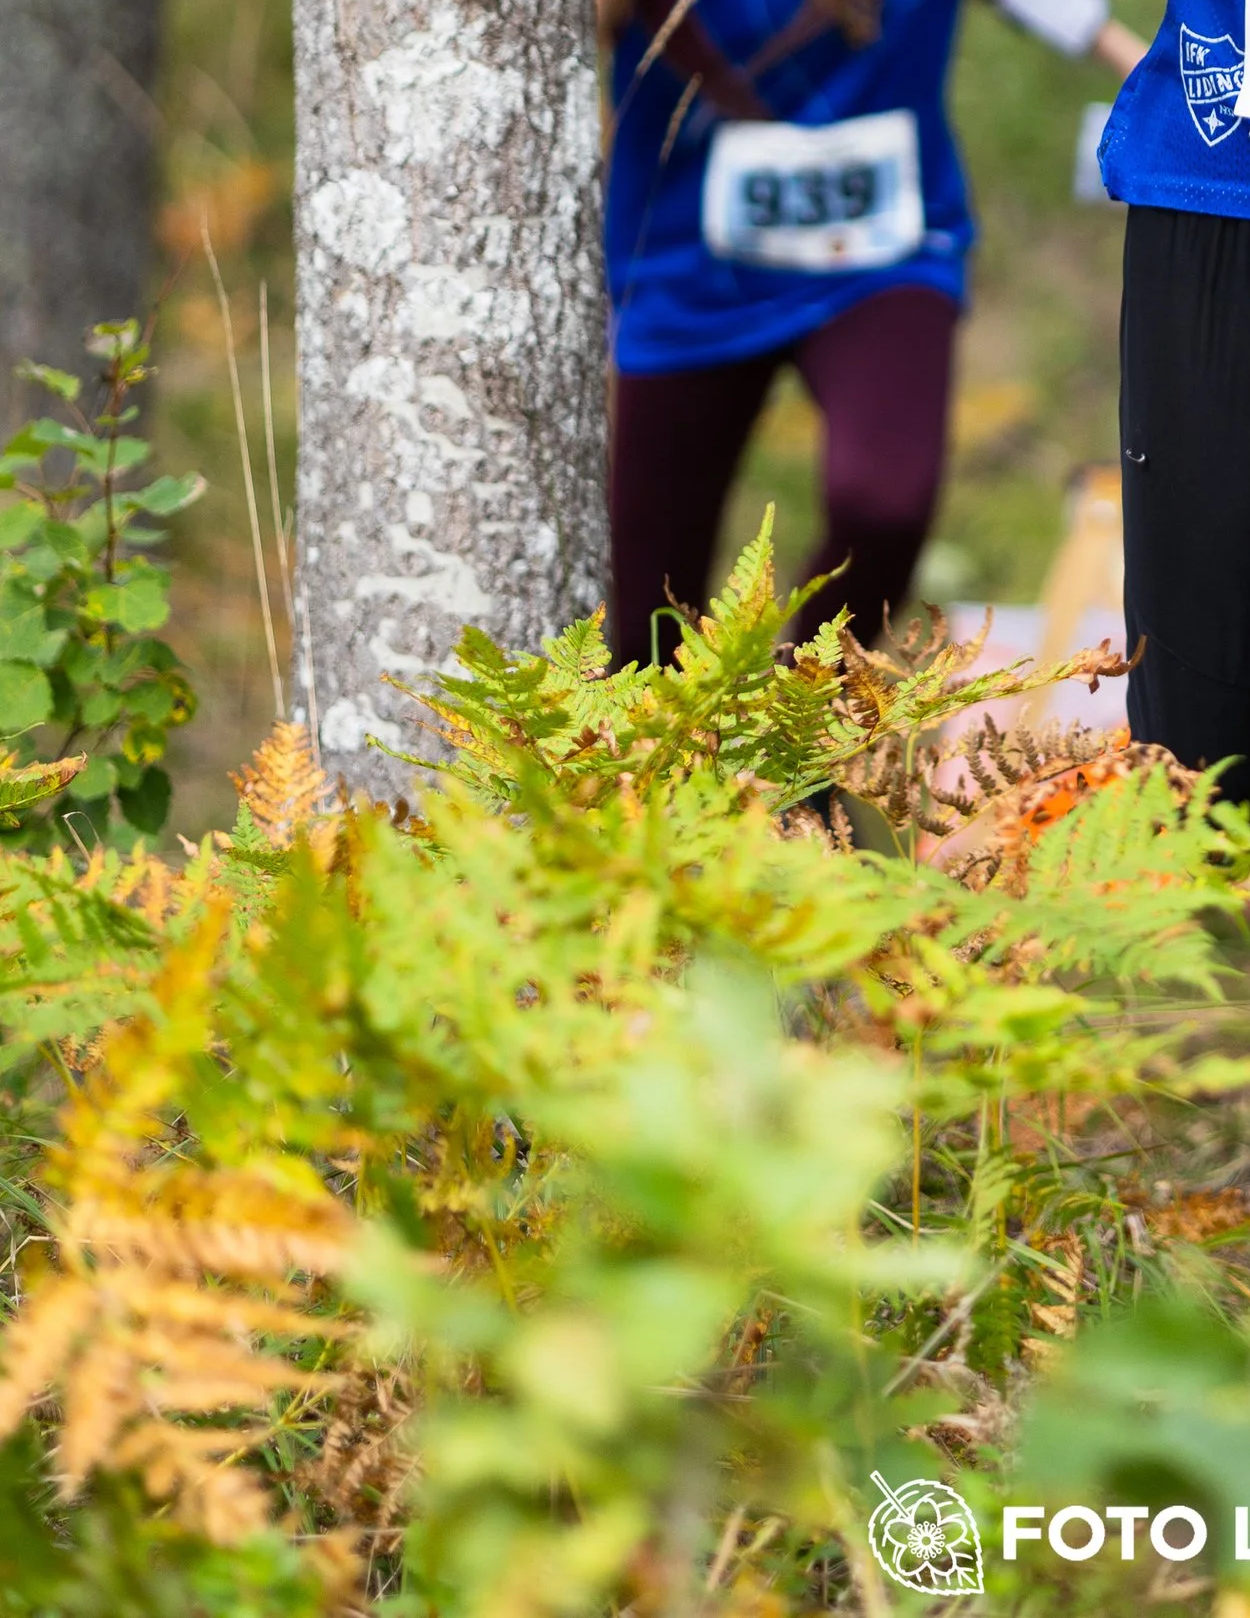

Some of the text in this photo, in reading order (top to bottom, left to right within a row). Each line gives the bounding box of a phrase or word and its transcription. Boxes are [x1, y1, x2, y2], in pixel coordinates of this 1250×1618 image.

[1185, 40, 1211, 68] IFK
[1188, 70, 1244, 99] LIDING
[742, 160, 877, 228] 939
